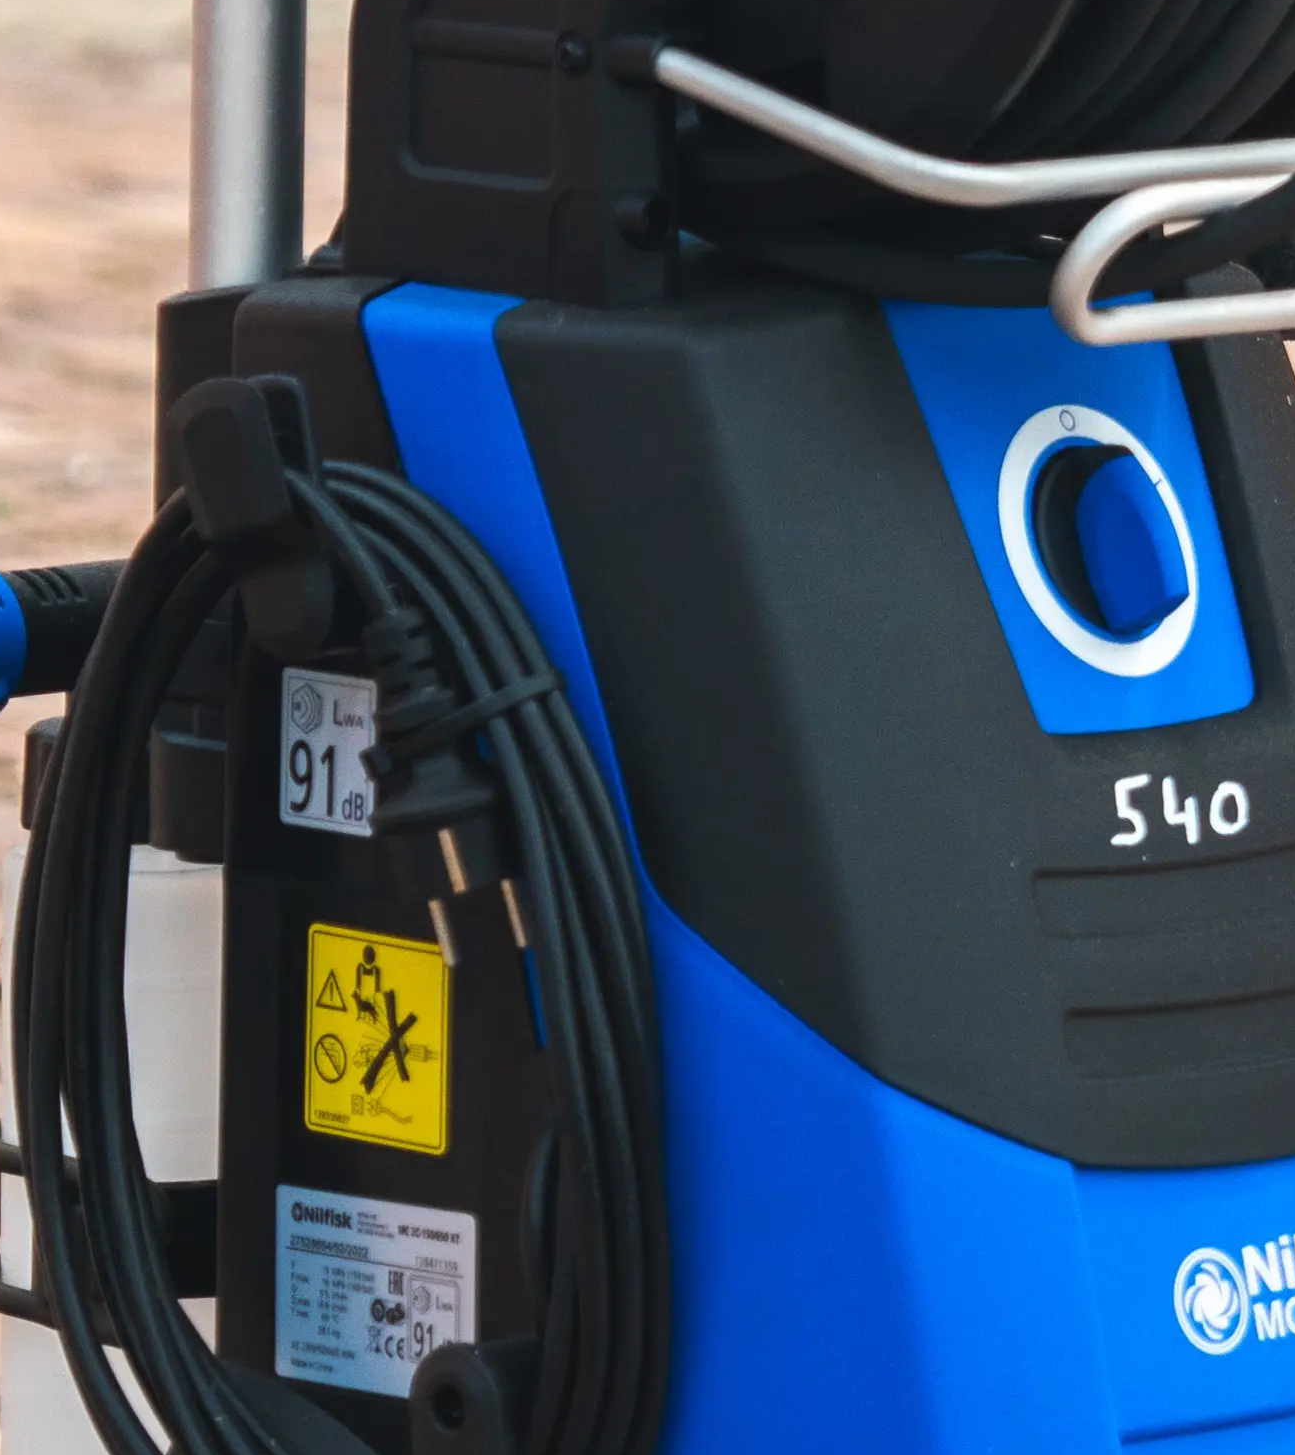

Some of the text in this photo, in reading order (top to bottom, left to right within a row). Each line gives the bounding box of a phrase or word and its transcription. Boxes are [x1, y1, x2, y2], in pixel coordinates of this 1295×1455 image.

[289, 739, 365, 822] 91 dB
[1110, 773, 1252, 848] 540
[304, 1206, 353, 1230] Nilfisk
[413, 1321, 434, 1358] 91
